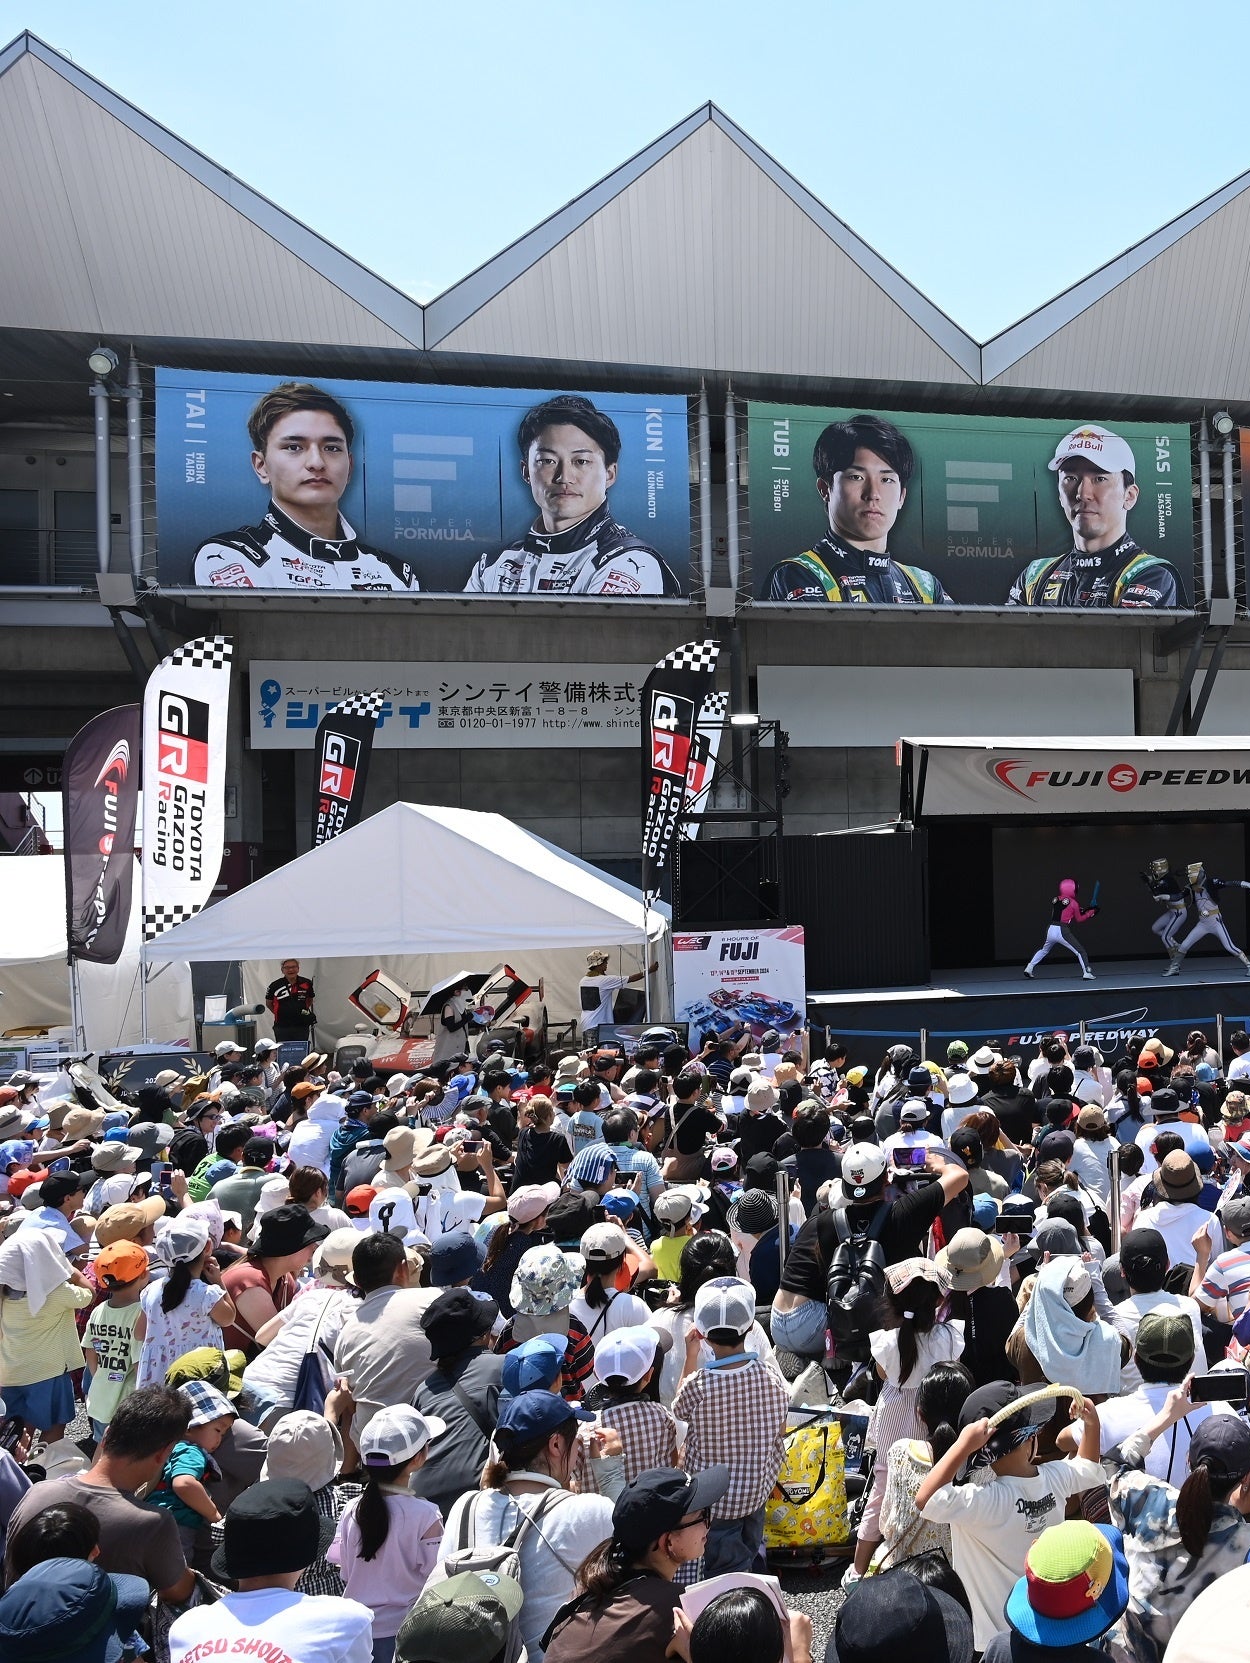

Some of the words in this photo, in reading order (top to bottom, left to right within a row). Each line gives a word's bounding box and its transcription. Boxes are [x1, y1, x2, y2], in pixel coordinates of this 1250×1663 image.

[186, 390, 205, 429] TAI
[645, 408, 662, 451] KUN
[773, 418, 789, 457] TUB
[1068, 440, 1083, 451] Red
[1084, 440, 1103, 452] Bull
[1156, 436, 1171, 473] SAS
[185, 452, 195, 483] TAIRA
[195, 452, 205, 484] HIBIKI
[656, 470, 664, 490] YUJI
[647, 470, 656, 519] KUNIMOTO
[773, 479, 781, 512] TSUBOI
[1164, 494, 1172, 516] UKYO
[1157, 494, 1165, 539] SASAHARA
[394, 527, 475, 541] FORMULA
[868, 557, 889, 568] TOM
[947, 546, 1014, 558] FORMULA
[286, 702, 430, 728] シテイ
[460, 718, 536, 728] 0120-01-1977
[159, 695, 188, 775] GR
[653, 695, 676, 769] GR
[321, 734, 346, 794] GR
[1026, 769, 1104, 788] FUJI
[103, 780, 118, 831] FUJI
[649, 778, 672, 857] GAZOO
[153, 780, 171, 867] Racing
[172, 785, 188, 872] GAZOO
[190, 789, 206, 882] TOYOTA
[677, 937, 702, 945] WEC
[719, 942, 759, 961] FUJI
[1008, 1036, 1045, 1046] FUJ
[90, 1322, 134, 1340] NISSAN
[179, 1638, 227, 1663] ETSU
